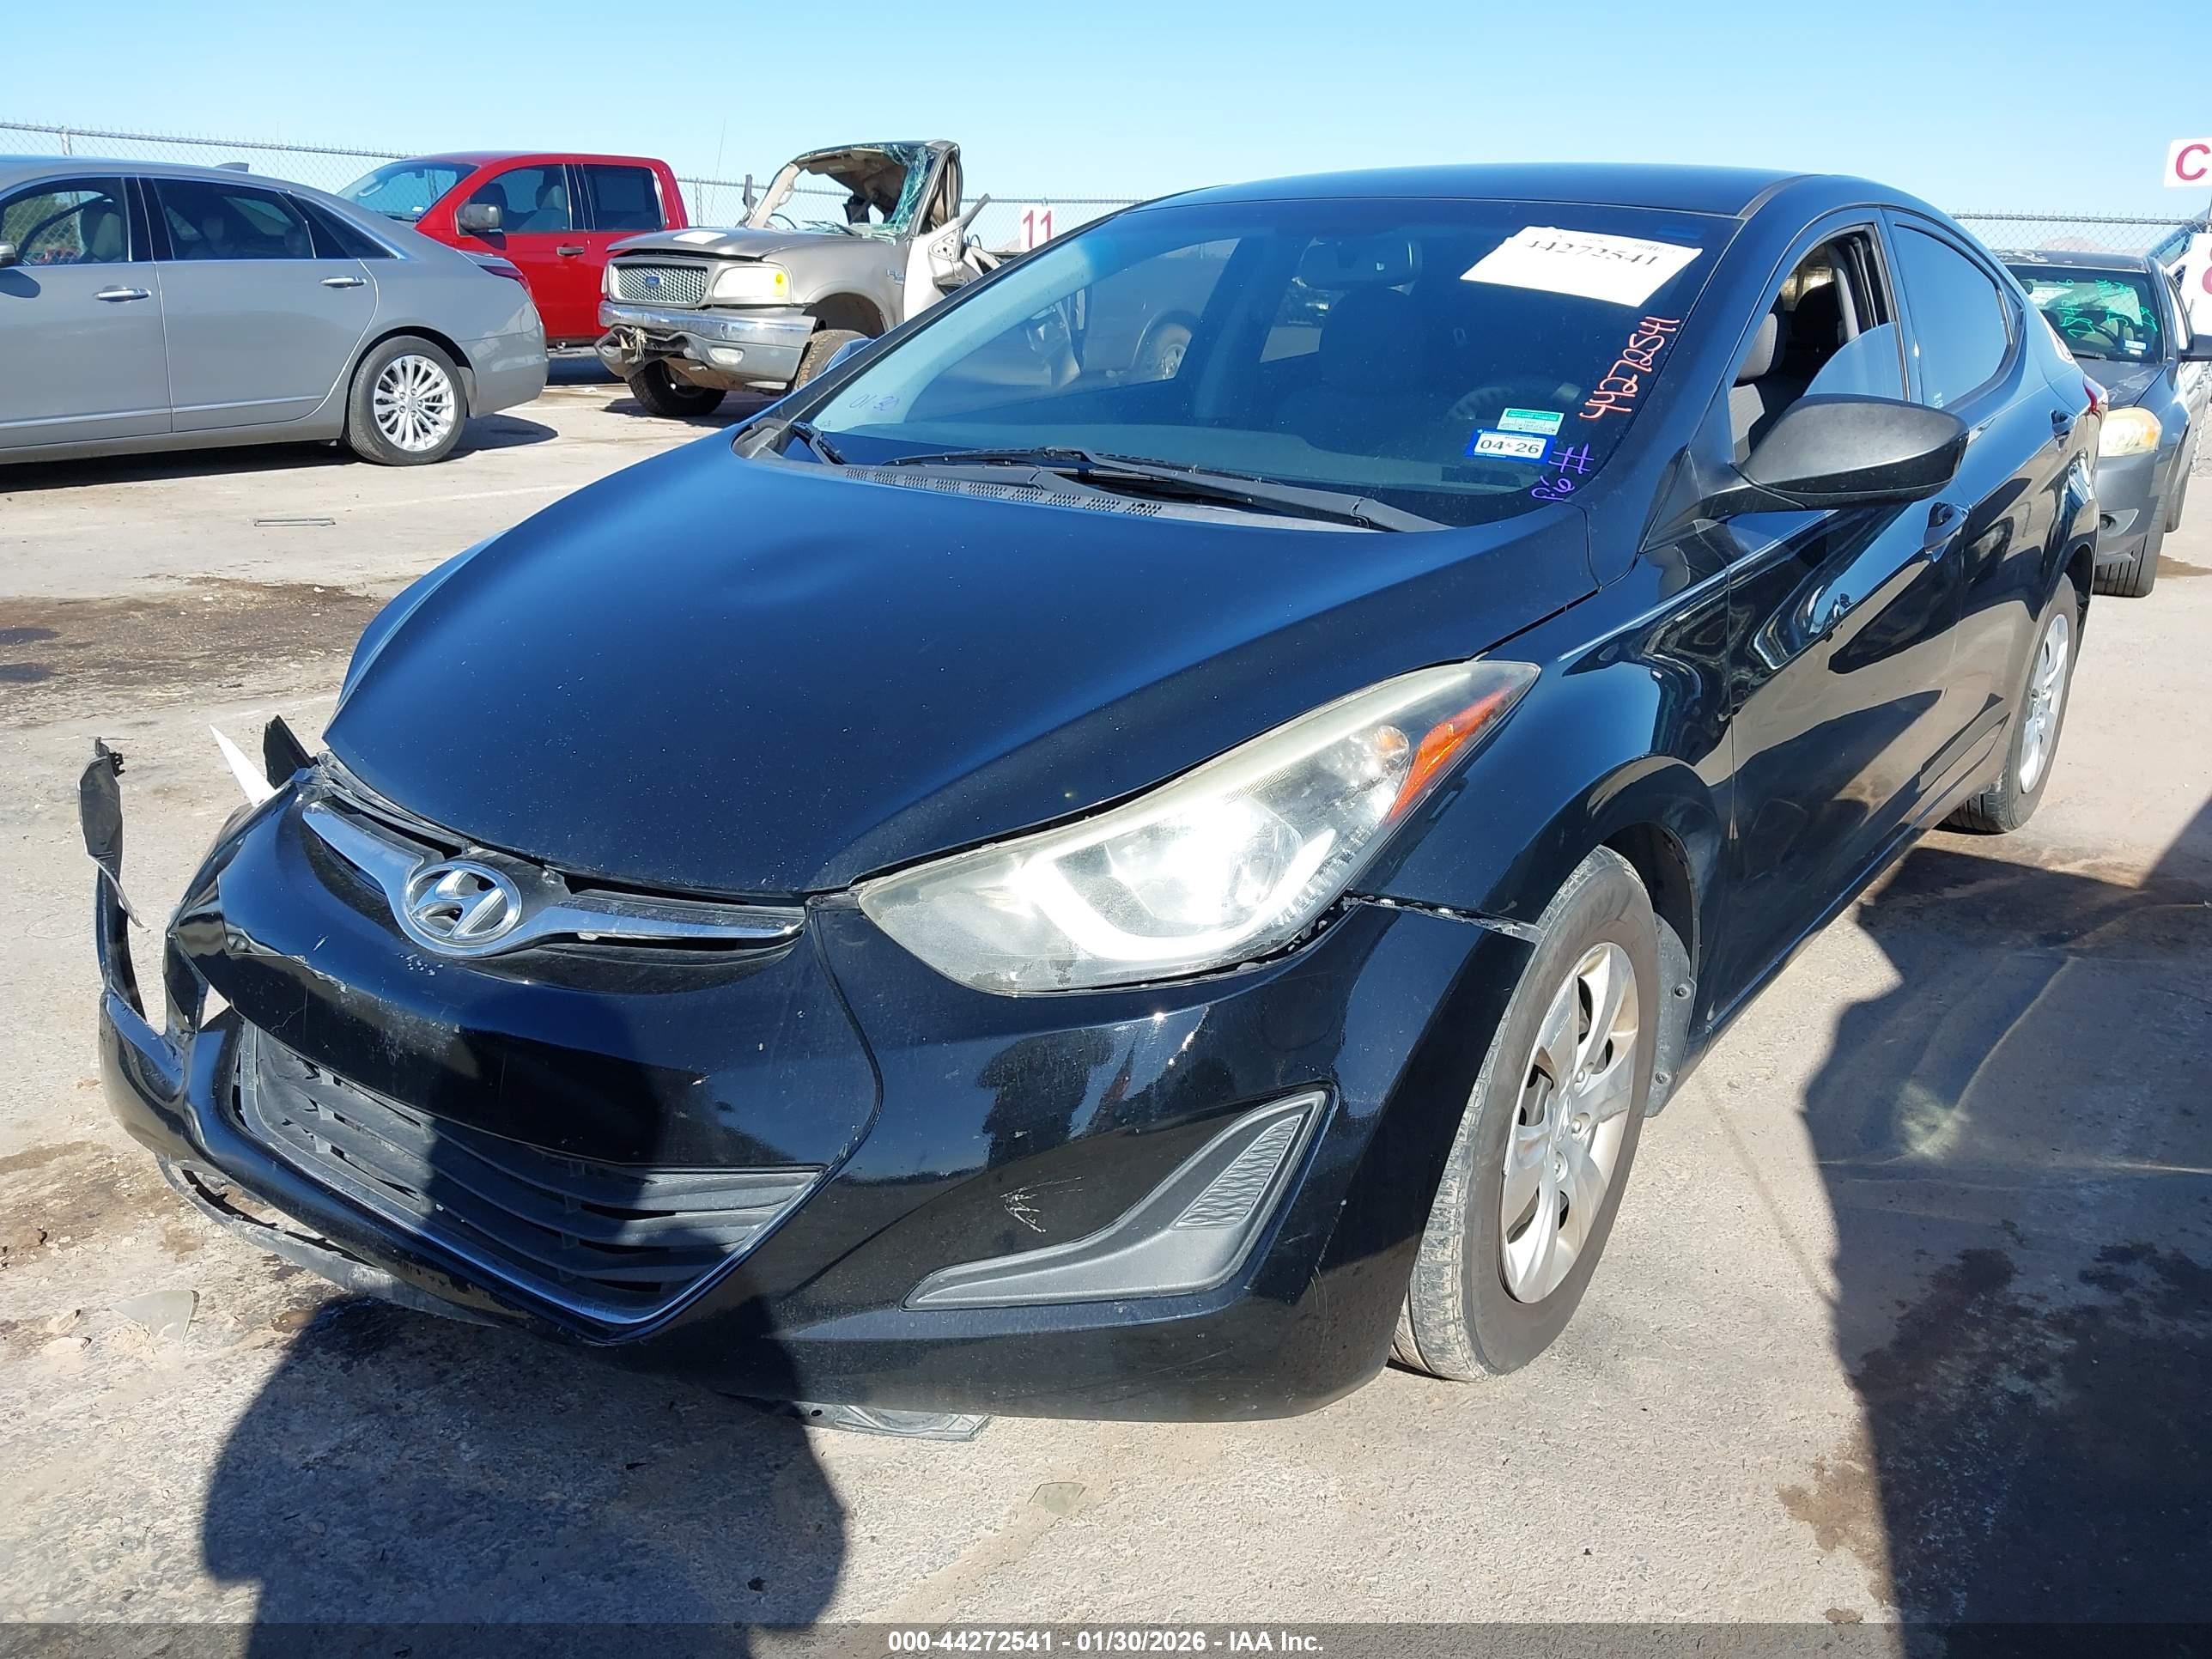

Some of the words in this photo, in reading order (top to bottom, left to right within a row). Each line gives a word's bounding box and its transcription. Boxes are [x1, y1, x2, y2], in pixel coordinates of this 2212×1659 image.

[2175, 143, 2211, 180] C
[1022, 210, 1052, 249] 11
[1578, 316, 1680, 420] 44272541
[1480, 439, 1504, 451] 04
[1514, 441, 1540, 454] 26
